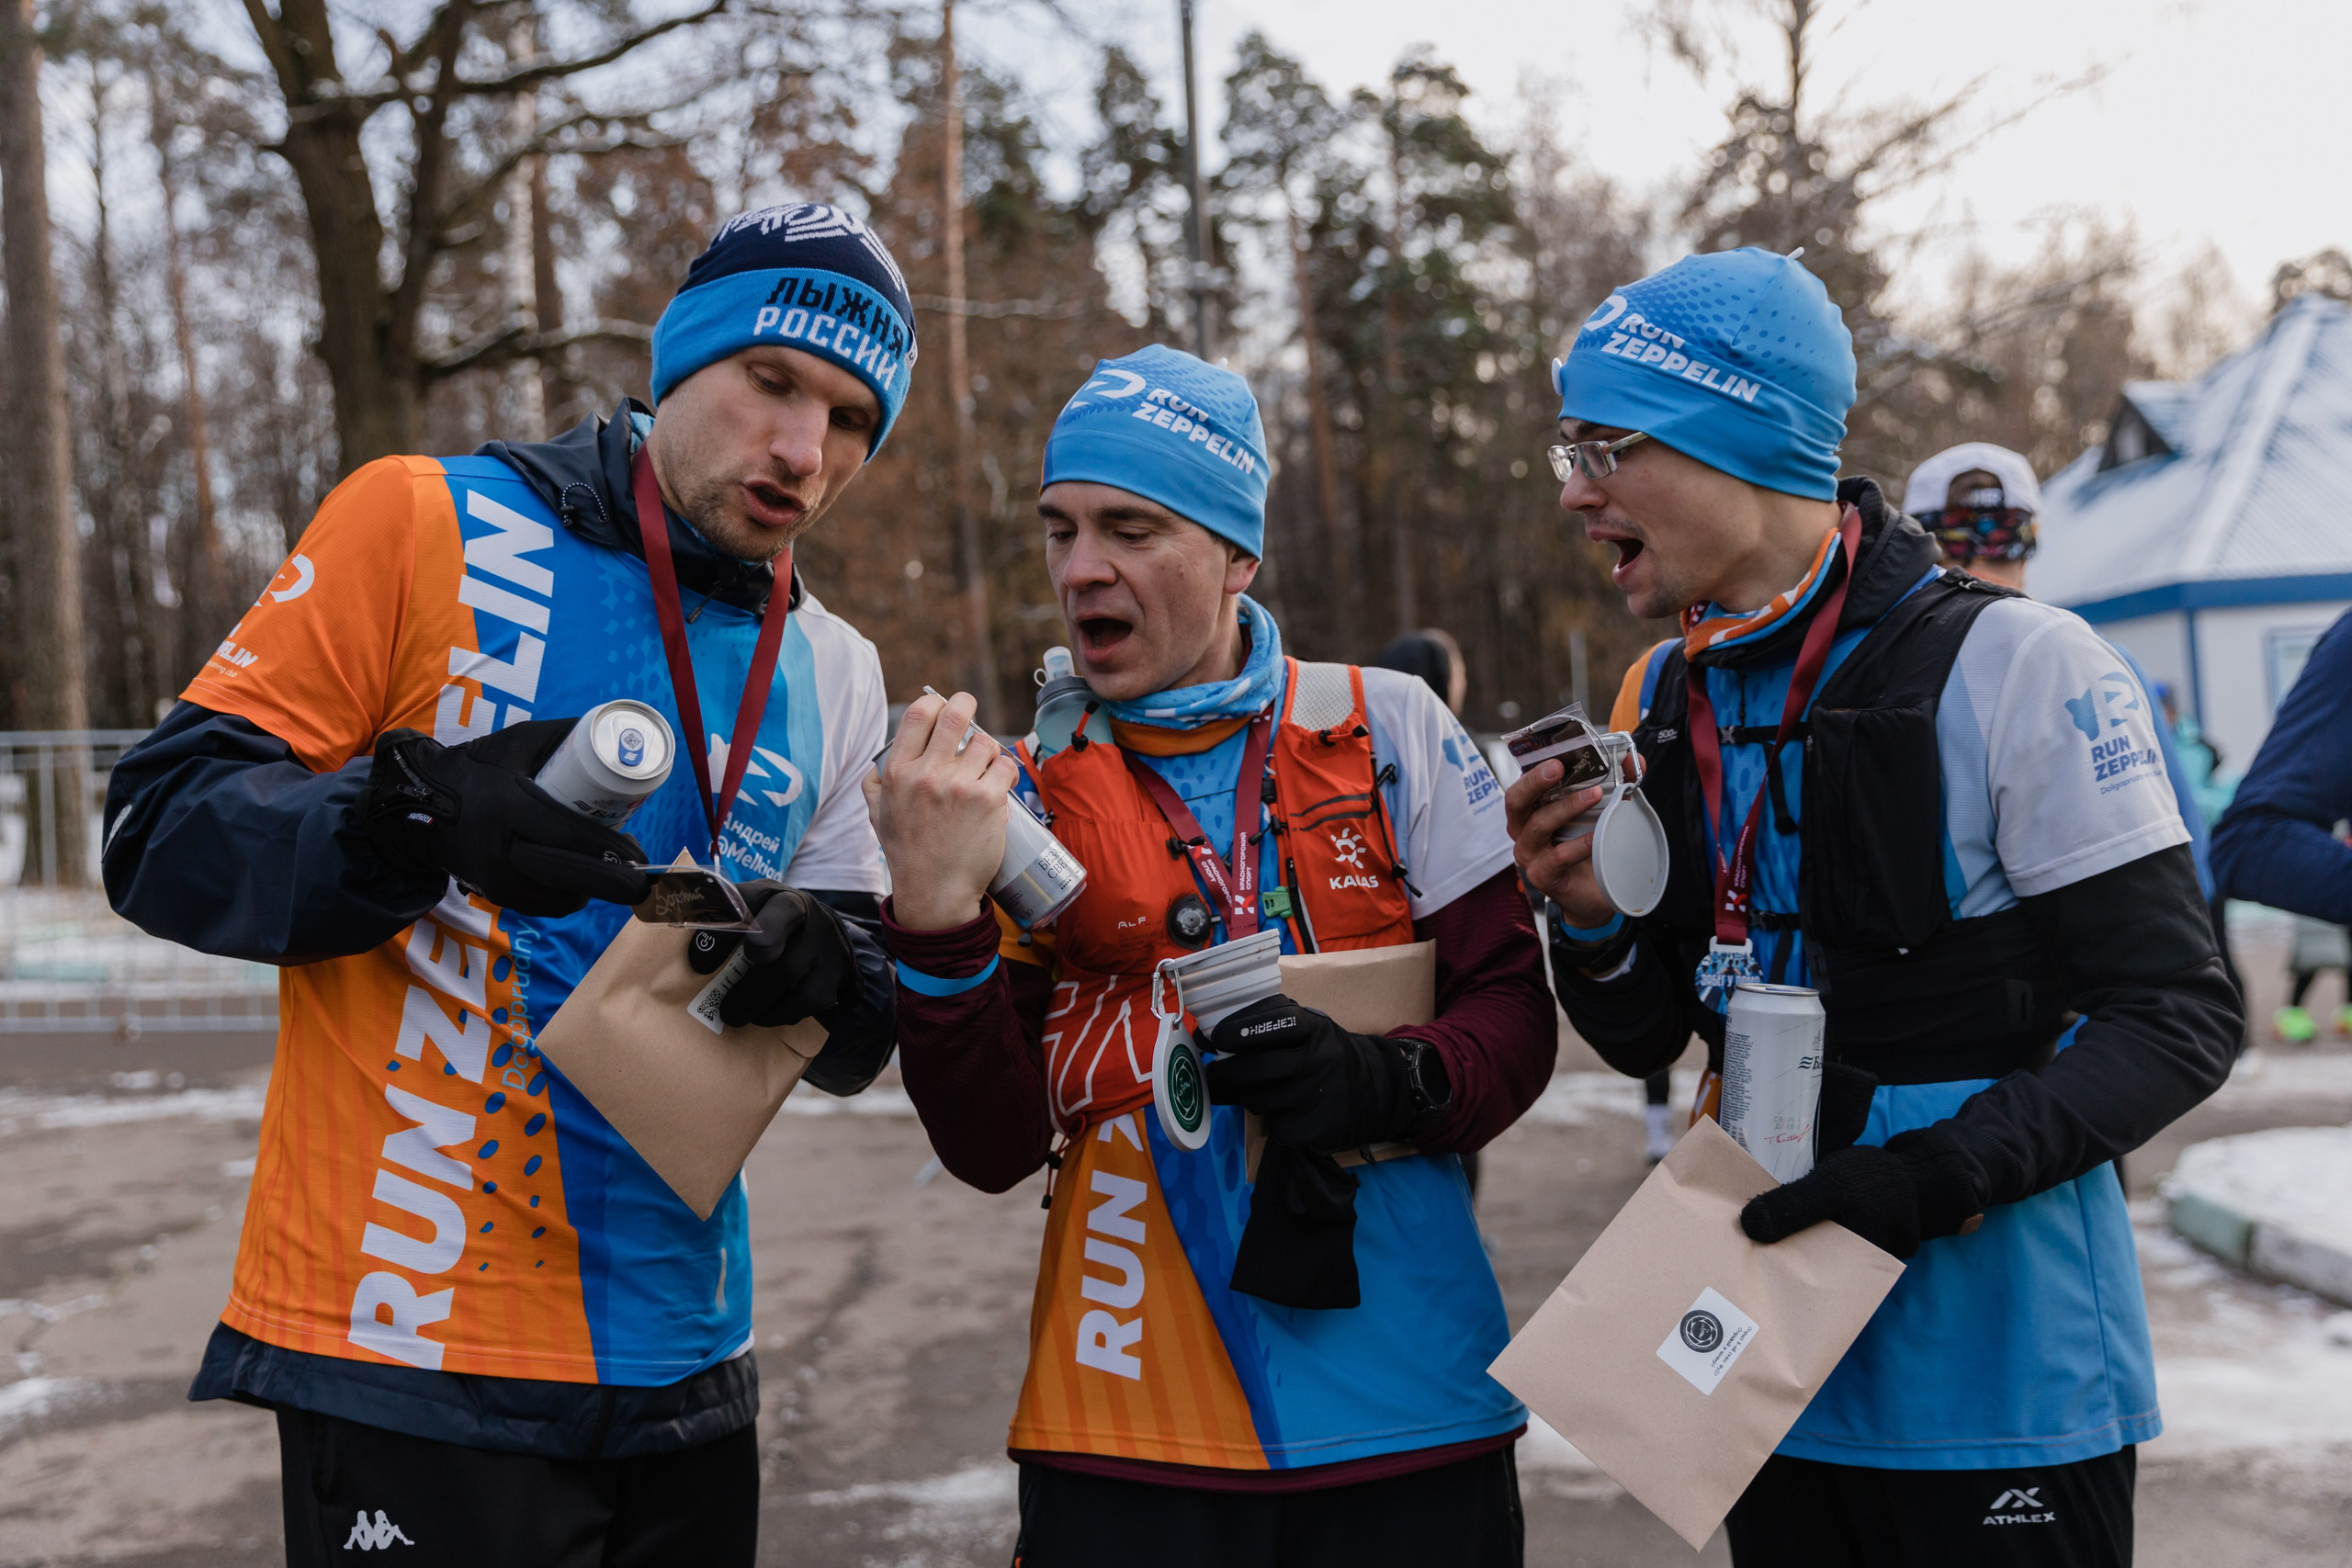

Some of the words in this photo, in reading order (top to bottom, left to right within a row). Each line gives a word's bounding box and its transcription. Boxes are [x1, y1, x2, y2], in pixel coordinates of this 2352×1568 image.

[765, 277, 903, 359] ЛЫЖНЯ
[1618, 312, 1686, 349] RUN
[753, 306, 898, 390] РОССИИ
[1600, 331, 1762, 402] ZEPPELIN
[1147, 388, 1209, 423] RUN
[1132, 401, 1256, 475] ZEPPELIN
[2091, 735, 2131, 763] RUN
[1463, 766, 1491, 791] RUN
[722, 810, 780, 854] Андрей
[1201, 861, 1216, 883] СПОРТ
[347, 1083, 477, 1371] RUN
[1075, 1168, 1148, 1381] RUN
[1983, 1511, 2057, 1525] ATHLEX
